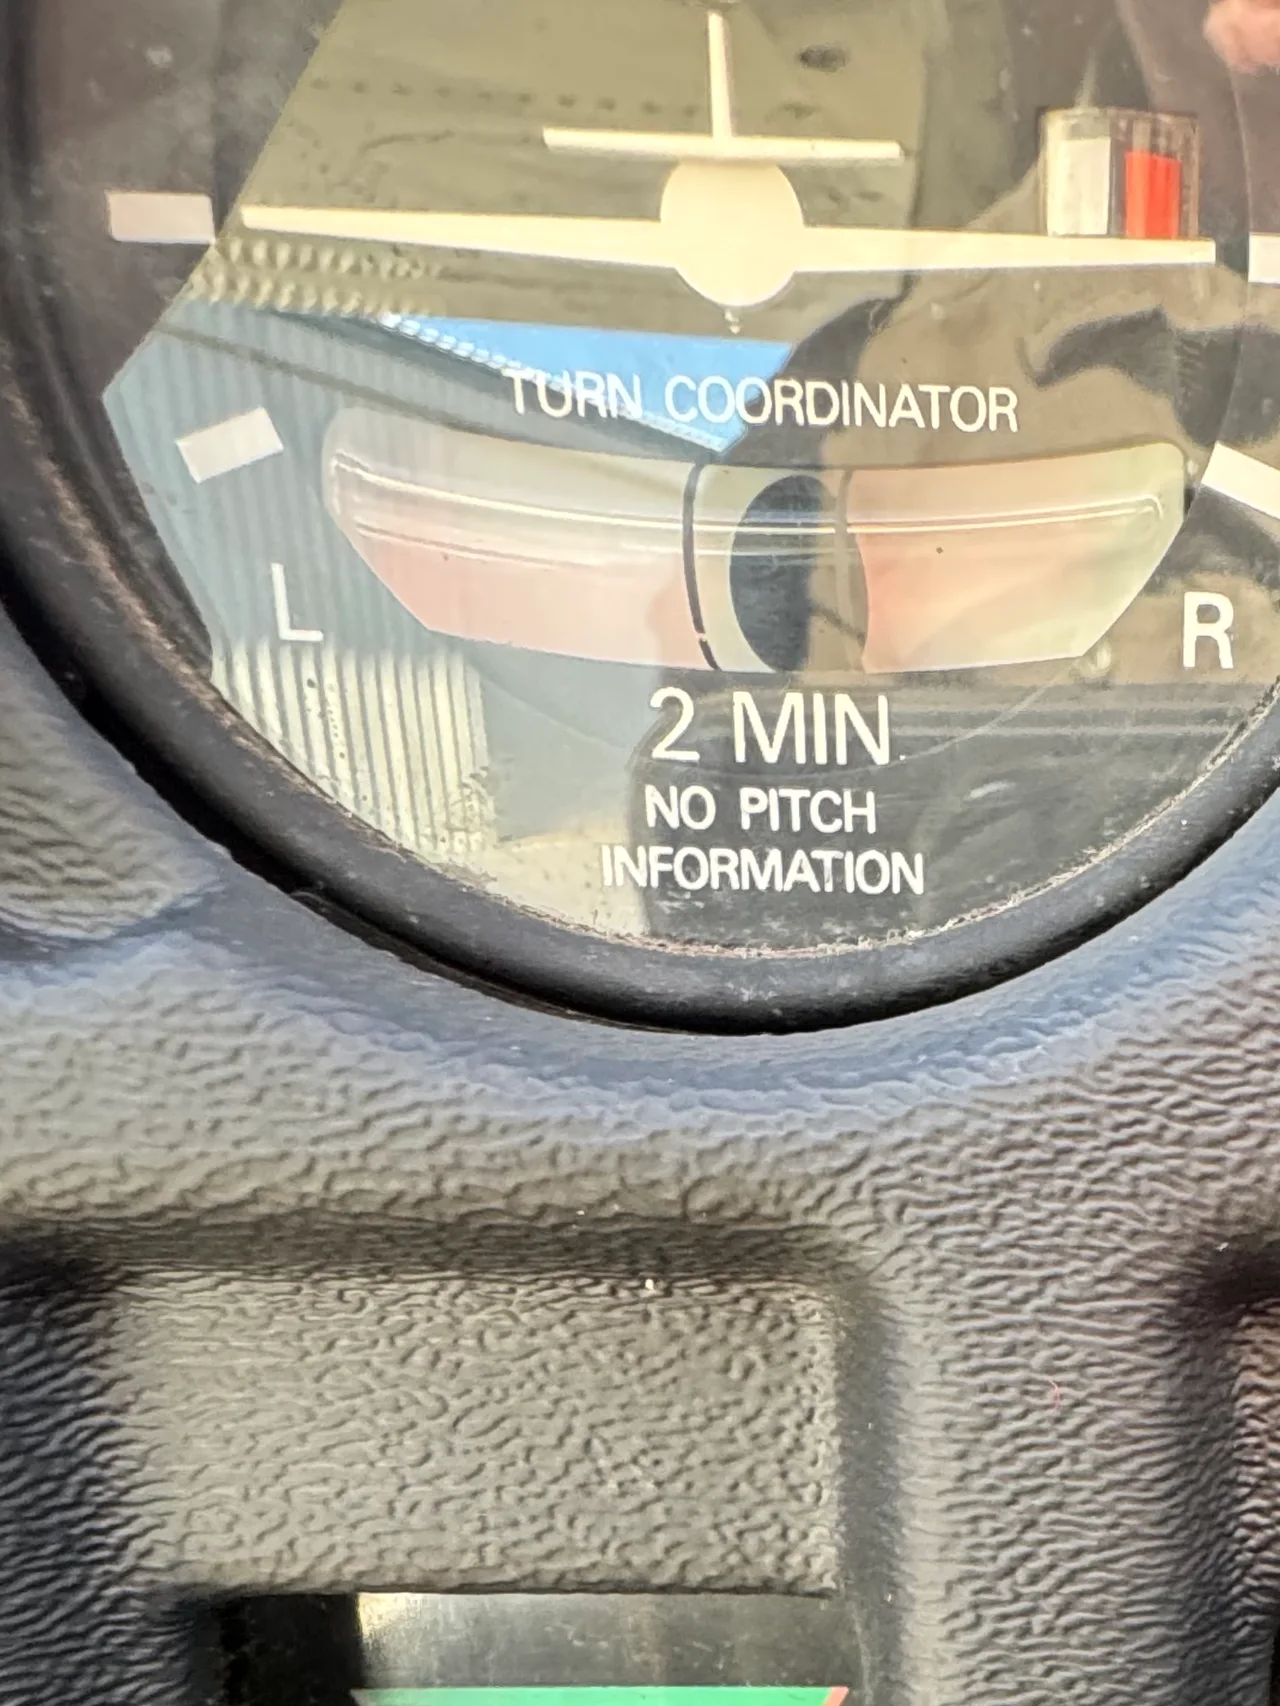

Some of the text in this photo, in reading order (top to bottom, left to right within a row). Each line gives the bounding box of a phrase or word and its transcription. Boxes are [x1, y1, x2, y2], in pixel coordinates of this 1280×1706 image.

[502, 367, 1019, 433] TURN COORDINATOR
[270, 563, 323, 643] L
[1182, 590, 1235, 671] R
[650, 688, 892, 767] 2 MIN
[645, 785, 877, 834] NO PITCH
[601, 847, 925, 896] INFORMATION
